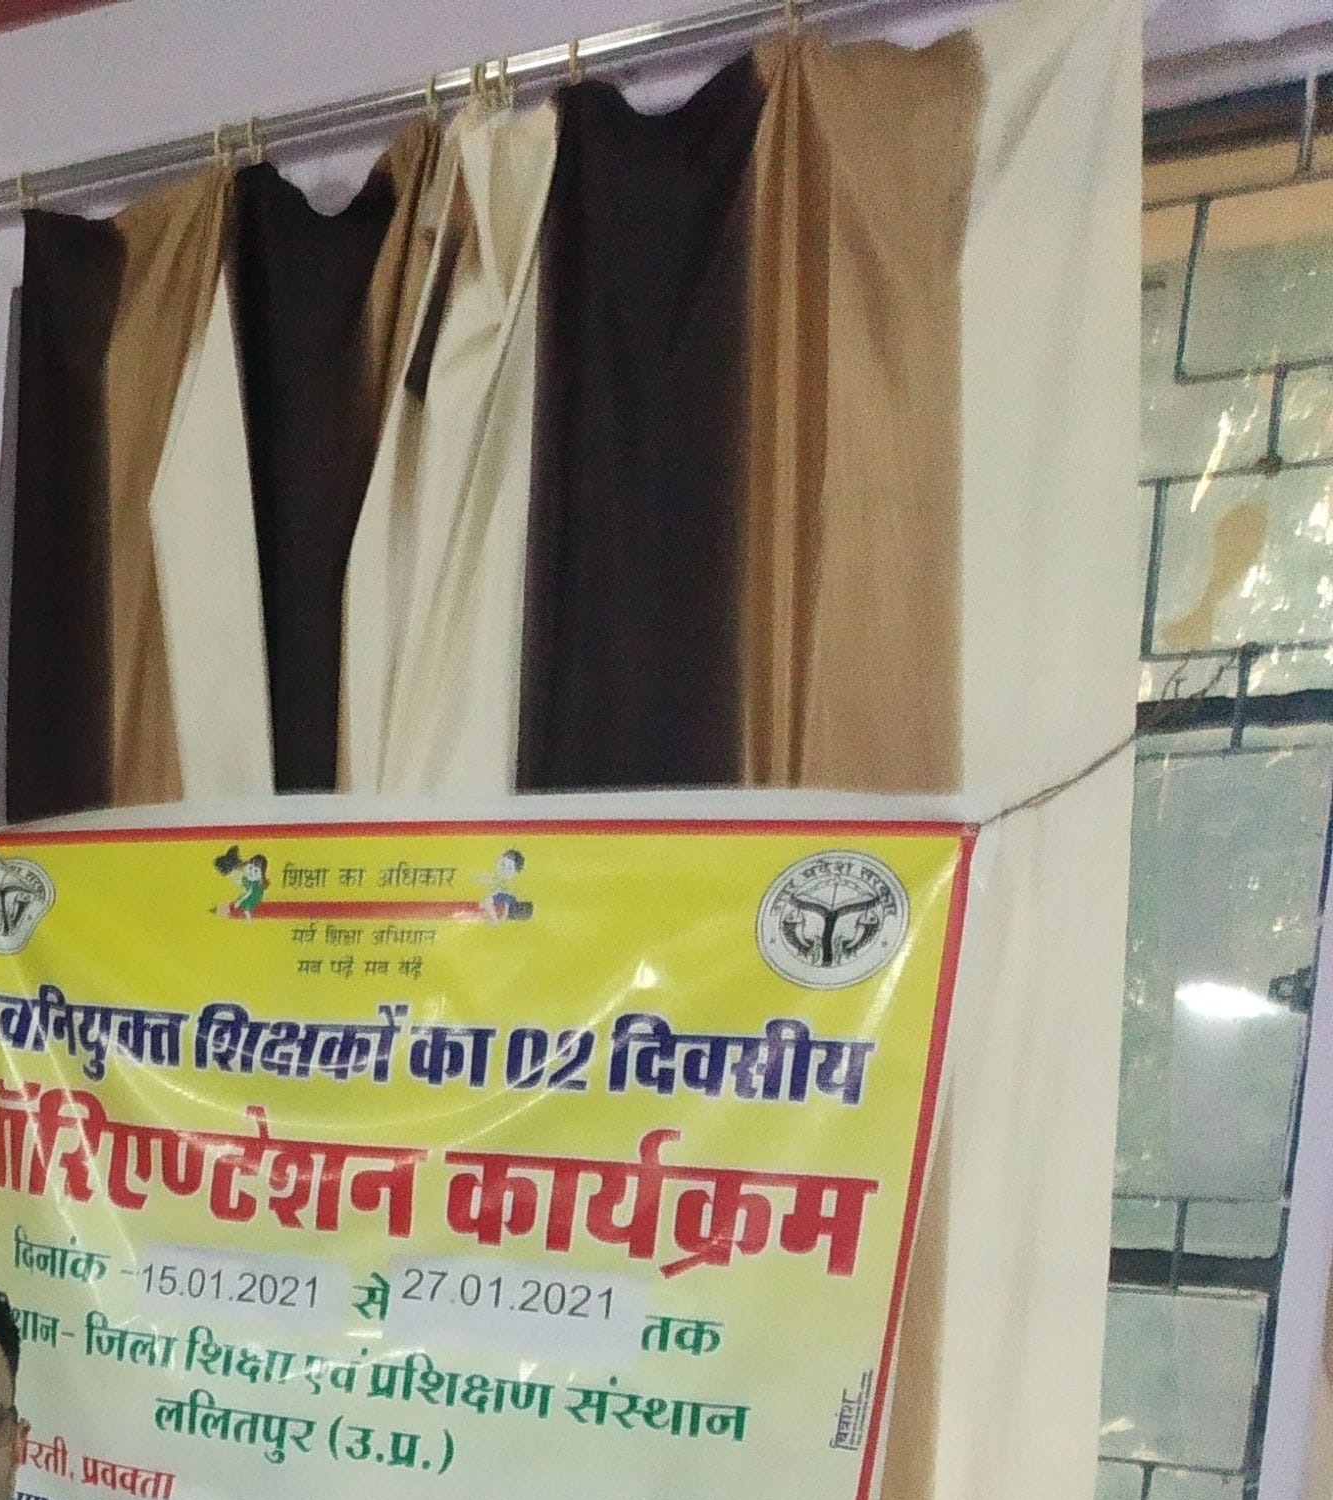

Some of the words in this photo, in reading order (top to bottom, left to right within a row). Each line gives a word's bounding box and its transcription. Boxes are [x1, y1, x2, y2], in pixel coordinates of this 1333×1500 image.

[282, 861, 329, 890] शिक्षा
[339, 867, 365, 889] का
[379, 860, 458, 889] अधिकार
[193, 1002, 409, 1082] शिक्षकों
[409, 1026, 496, 1088] का
[506, 1026, 596, 1091] 02
[608, 1013, 877, 1104] दिवसीय
[445, 1128, 879, 1279] कार्यक्रम
[14, 1224, 112, 1283] दिनांक
[351, 1271, 390, 1321] से
[401, 1268, 615, 1319] 27.01.2021
[639, 1314, 725, 1356] तक
[84, 1310, 179, 1369] जिला
[184, 1325, 296, 1384] शिक्षा
[305, 1347, 368, 1396] एवं
[367, 1353, 556, 1419] प्रशिक्षण
[565, 1375, 752, 1442] संस्थान
[154, 1388, 317, 1465] ललितपुर
